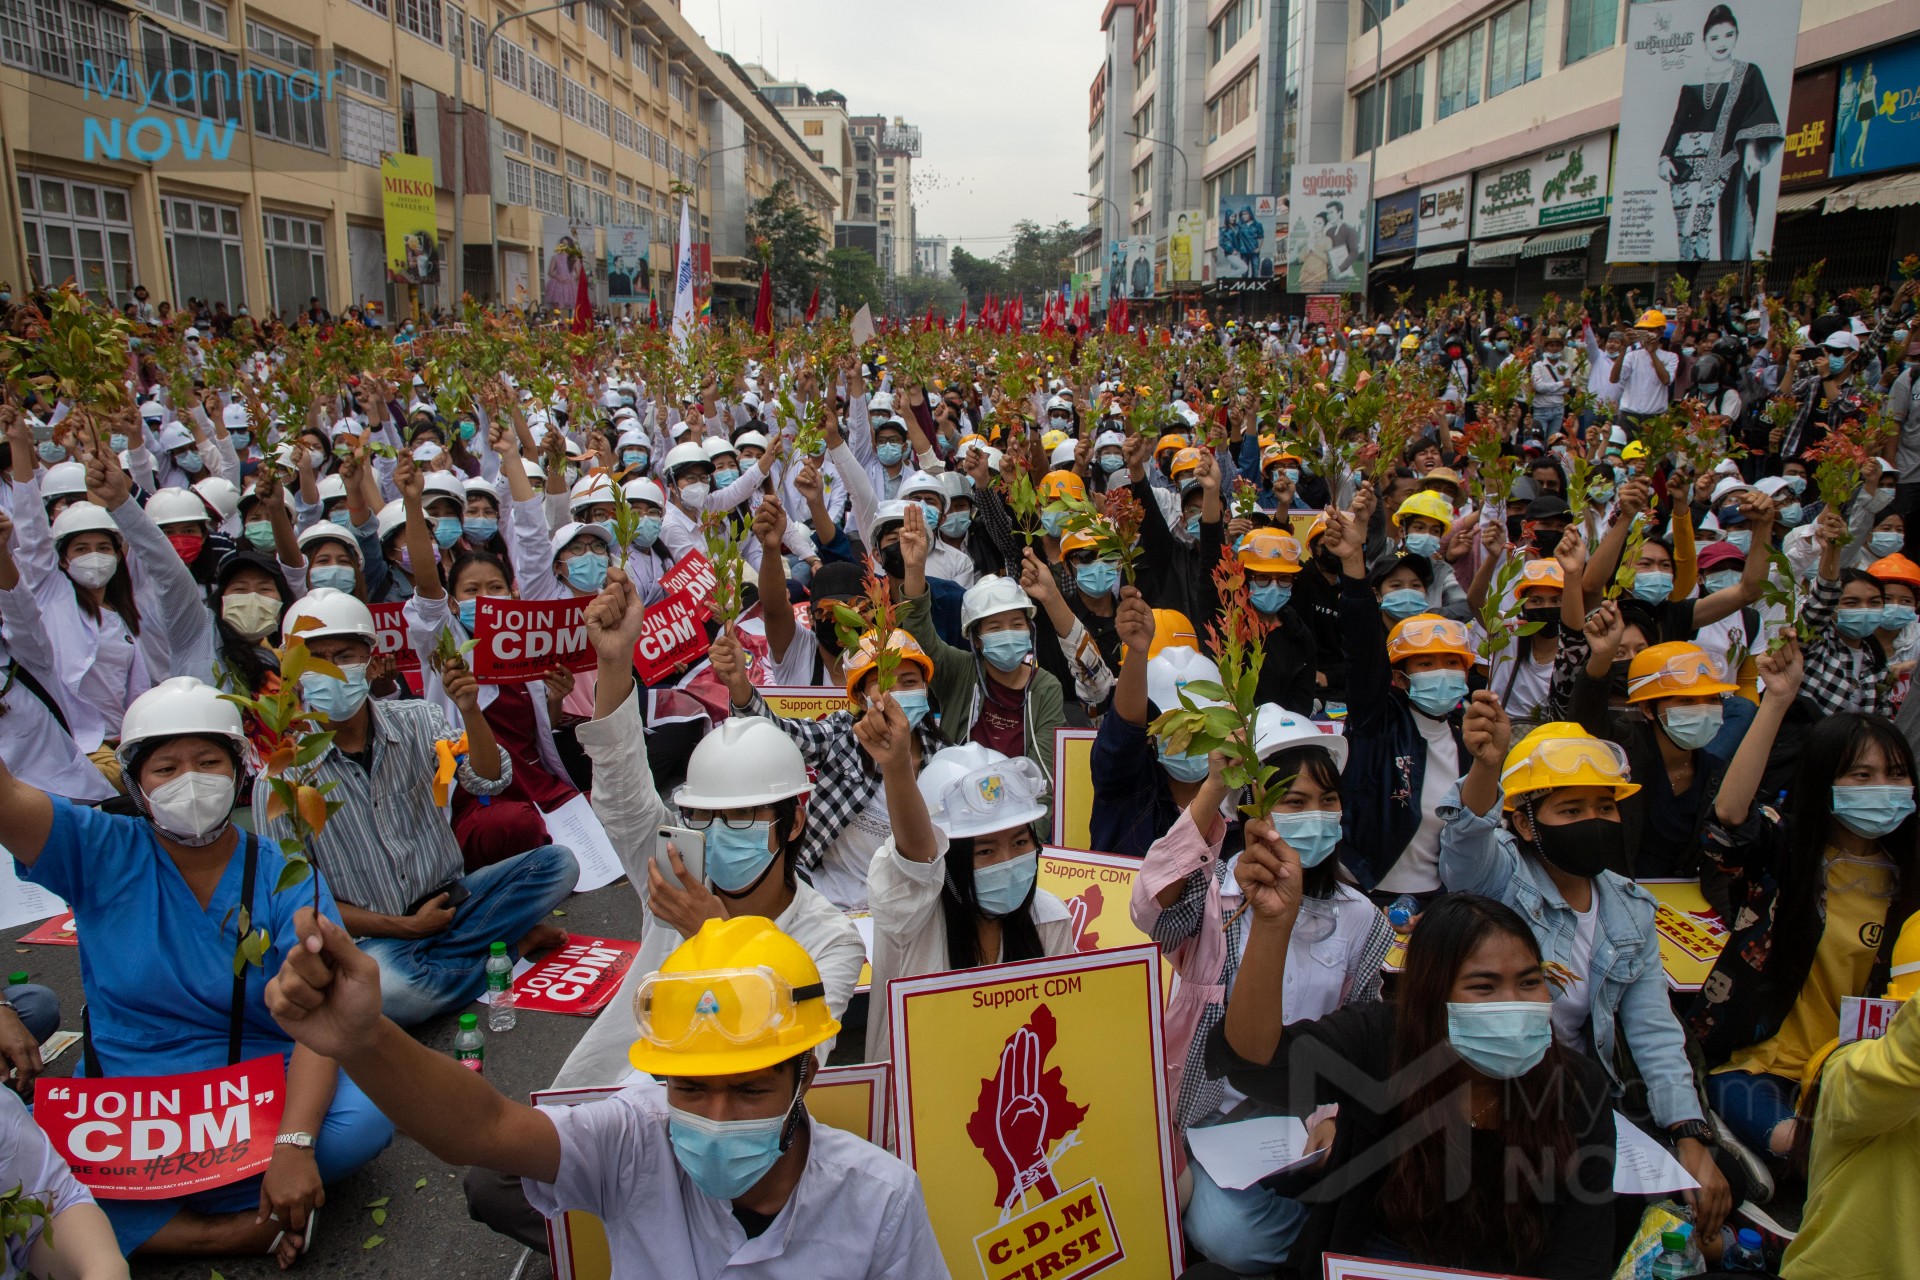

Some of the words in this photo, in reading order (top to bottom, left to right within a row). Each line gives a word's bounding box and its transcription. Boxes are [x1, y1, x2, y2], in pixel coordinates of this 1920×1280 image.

[385, 176, 433, 198] MIKKO
[1219, 280, 1267, 291] i-MAX
[687, 557, 704, 574] IN
[375, 611, 401, 629] IN
[668, 601, 686, 621] IN
[508, 661, 528, 669] OUR
[780, 698, 822, 712] Support
[826, 700, 850, 710] CDM
[1044, 861, 1096, 880] Support
[1100, 869, 1131, 885] CDM
[558, 945, 591, 960] IN
[972, 983, 1038, 1009] Support
[1043, 976, 1082, 997] CDM
[203, 1075, 249, 1110] IN
[70, 1165, 93, 1175] BE
[99, 1165, 137, 1176] OUR
[143, 1138, 250, 1182] HEROES
[988, 1194, 1098, 1266] C.D.M
